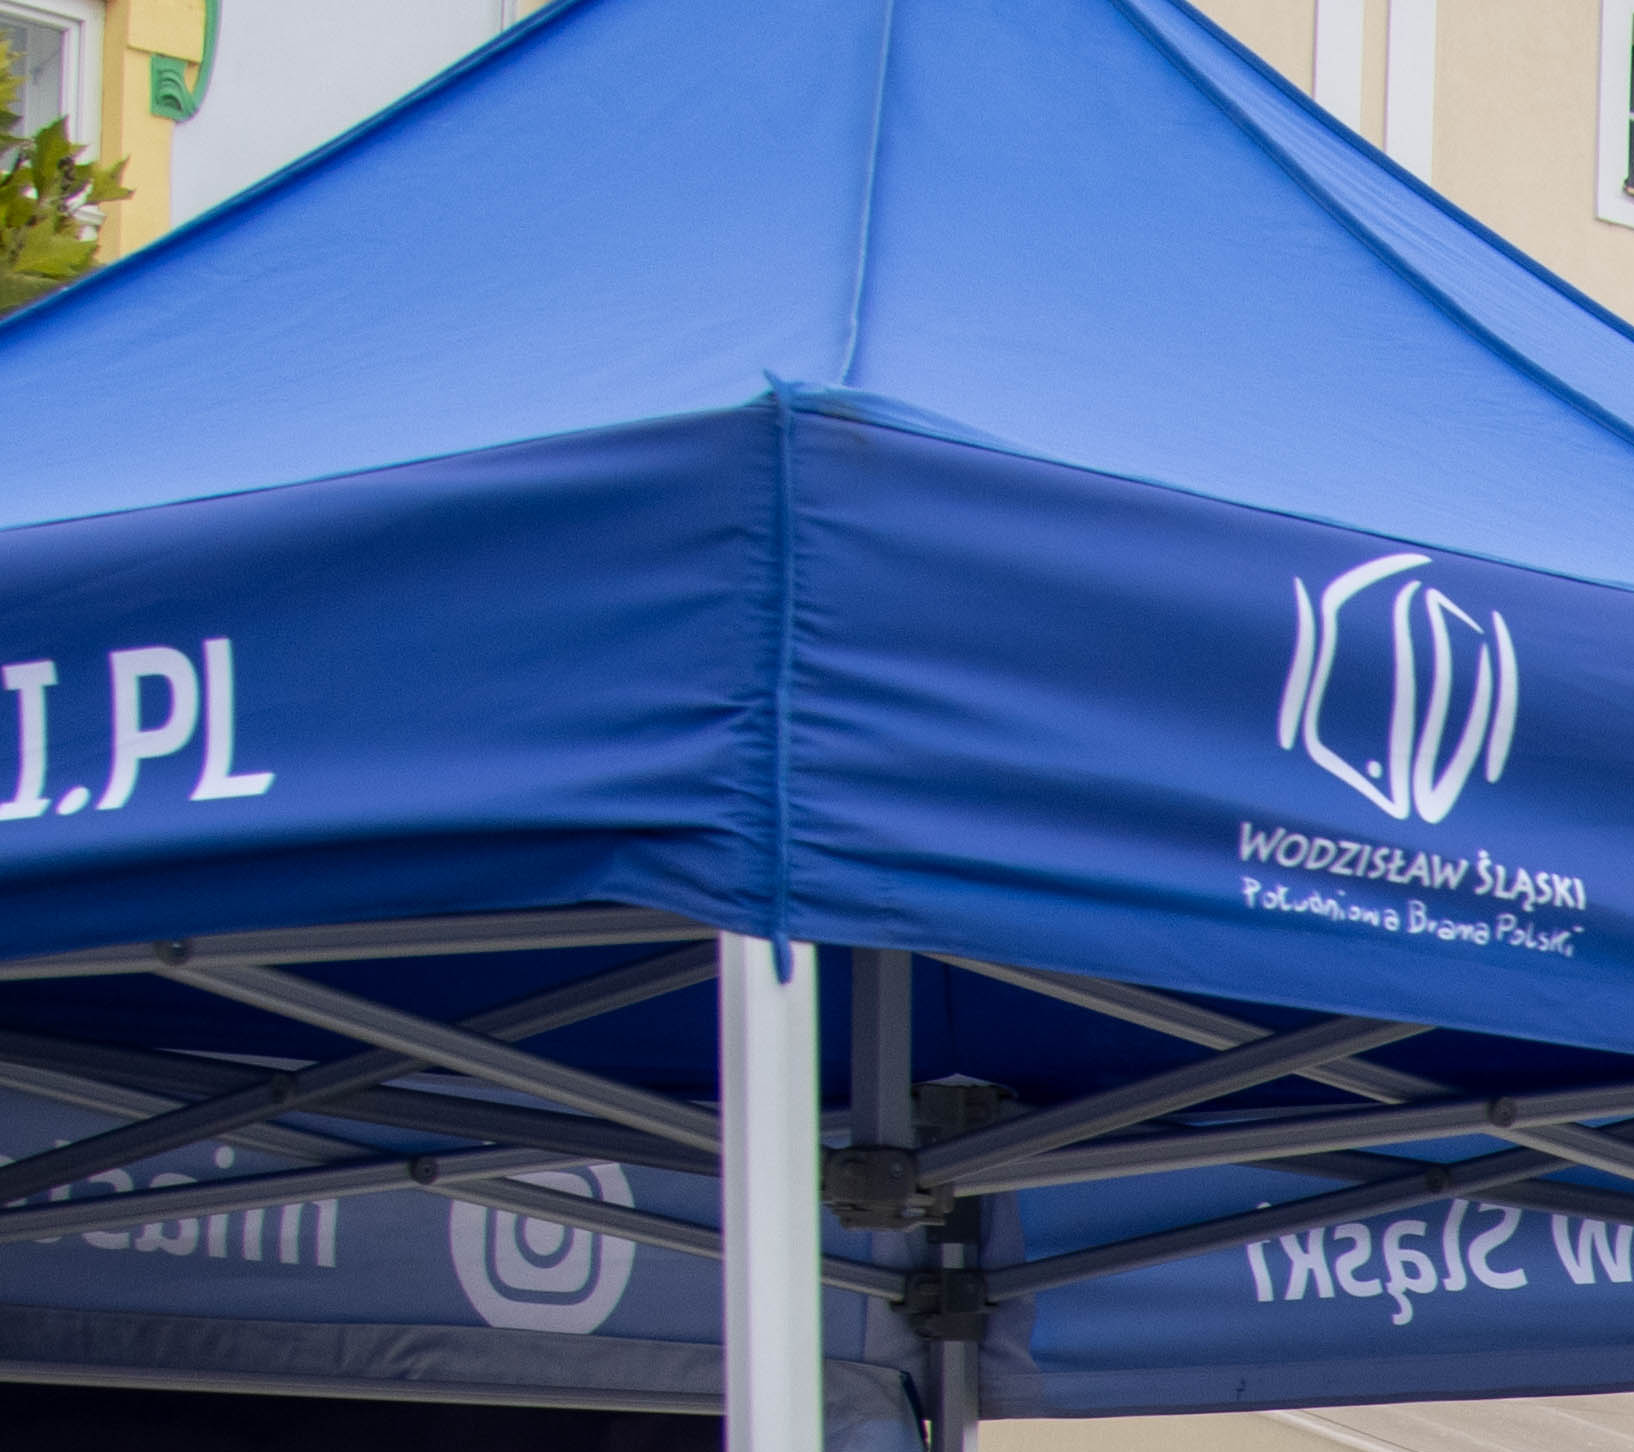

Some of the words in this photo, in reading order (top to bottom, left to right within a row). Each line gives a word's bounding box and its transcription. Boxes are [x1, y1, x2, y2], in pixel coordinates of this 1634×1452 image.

[1238, 821, 1469, 894] WODZISŁAW
[1476, 849, 1588, 913] ŚLĄSKI
[1240, 876, 1399, 933] Południowa
[1407, 900, 1490, 945] Brama
